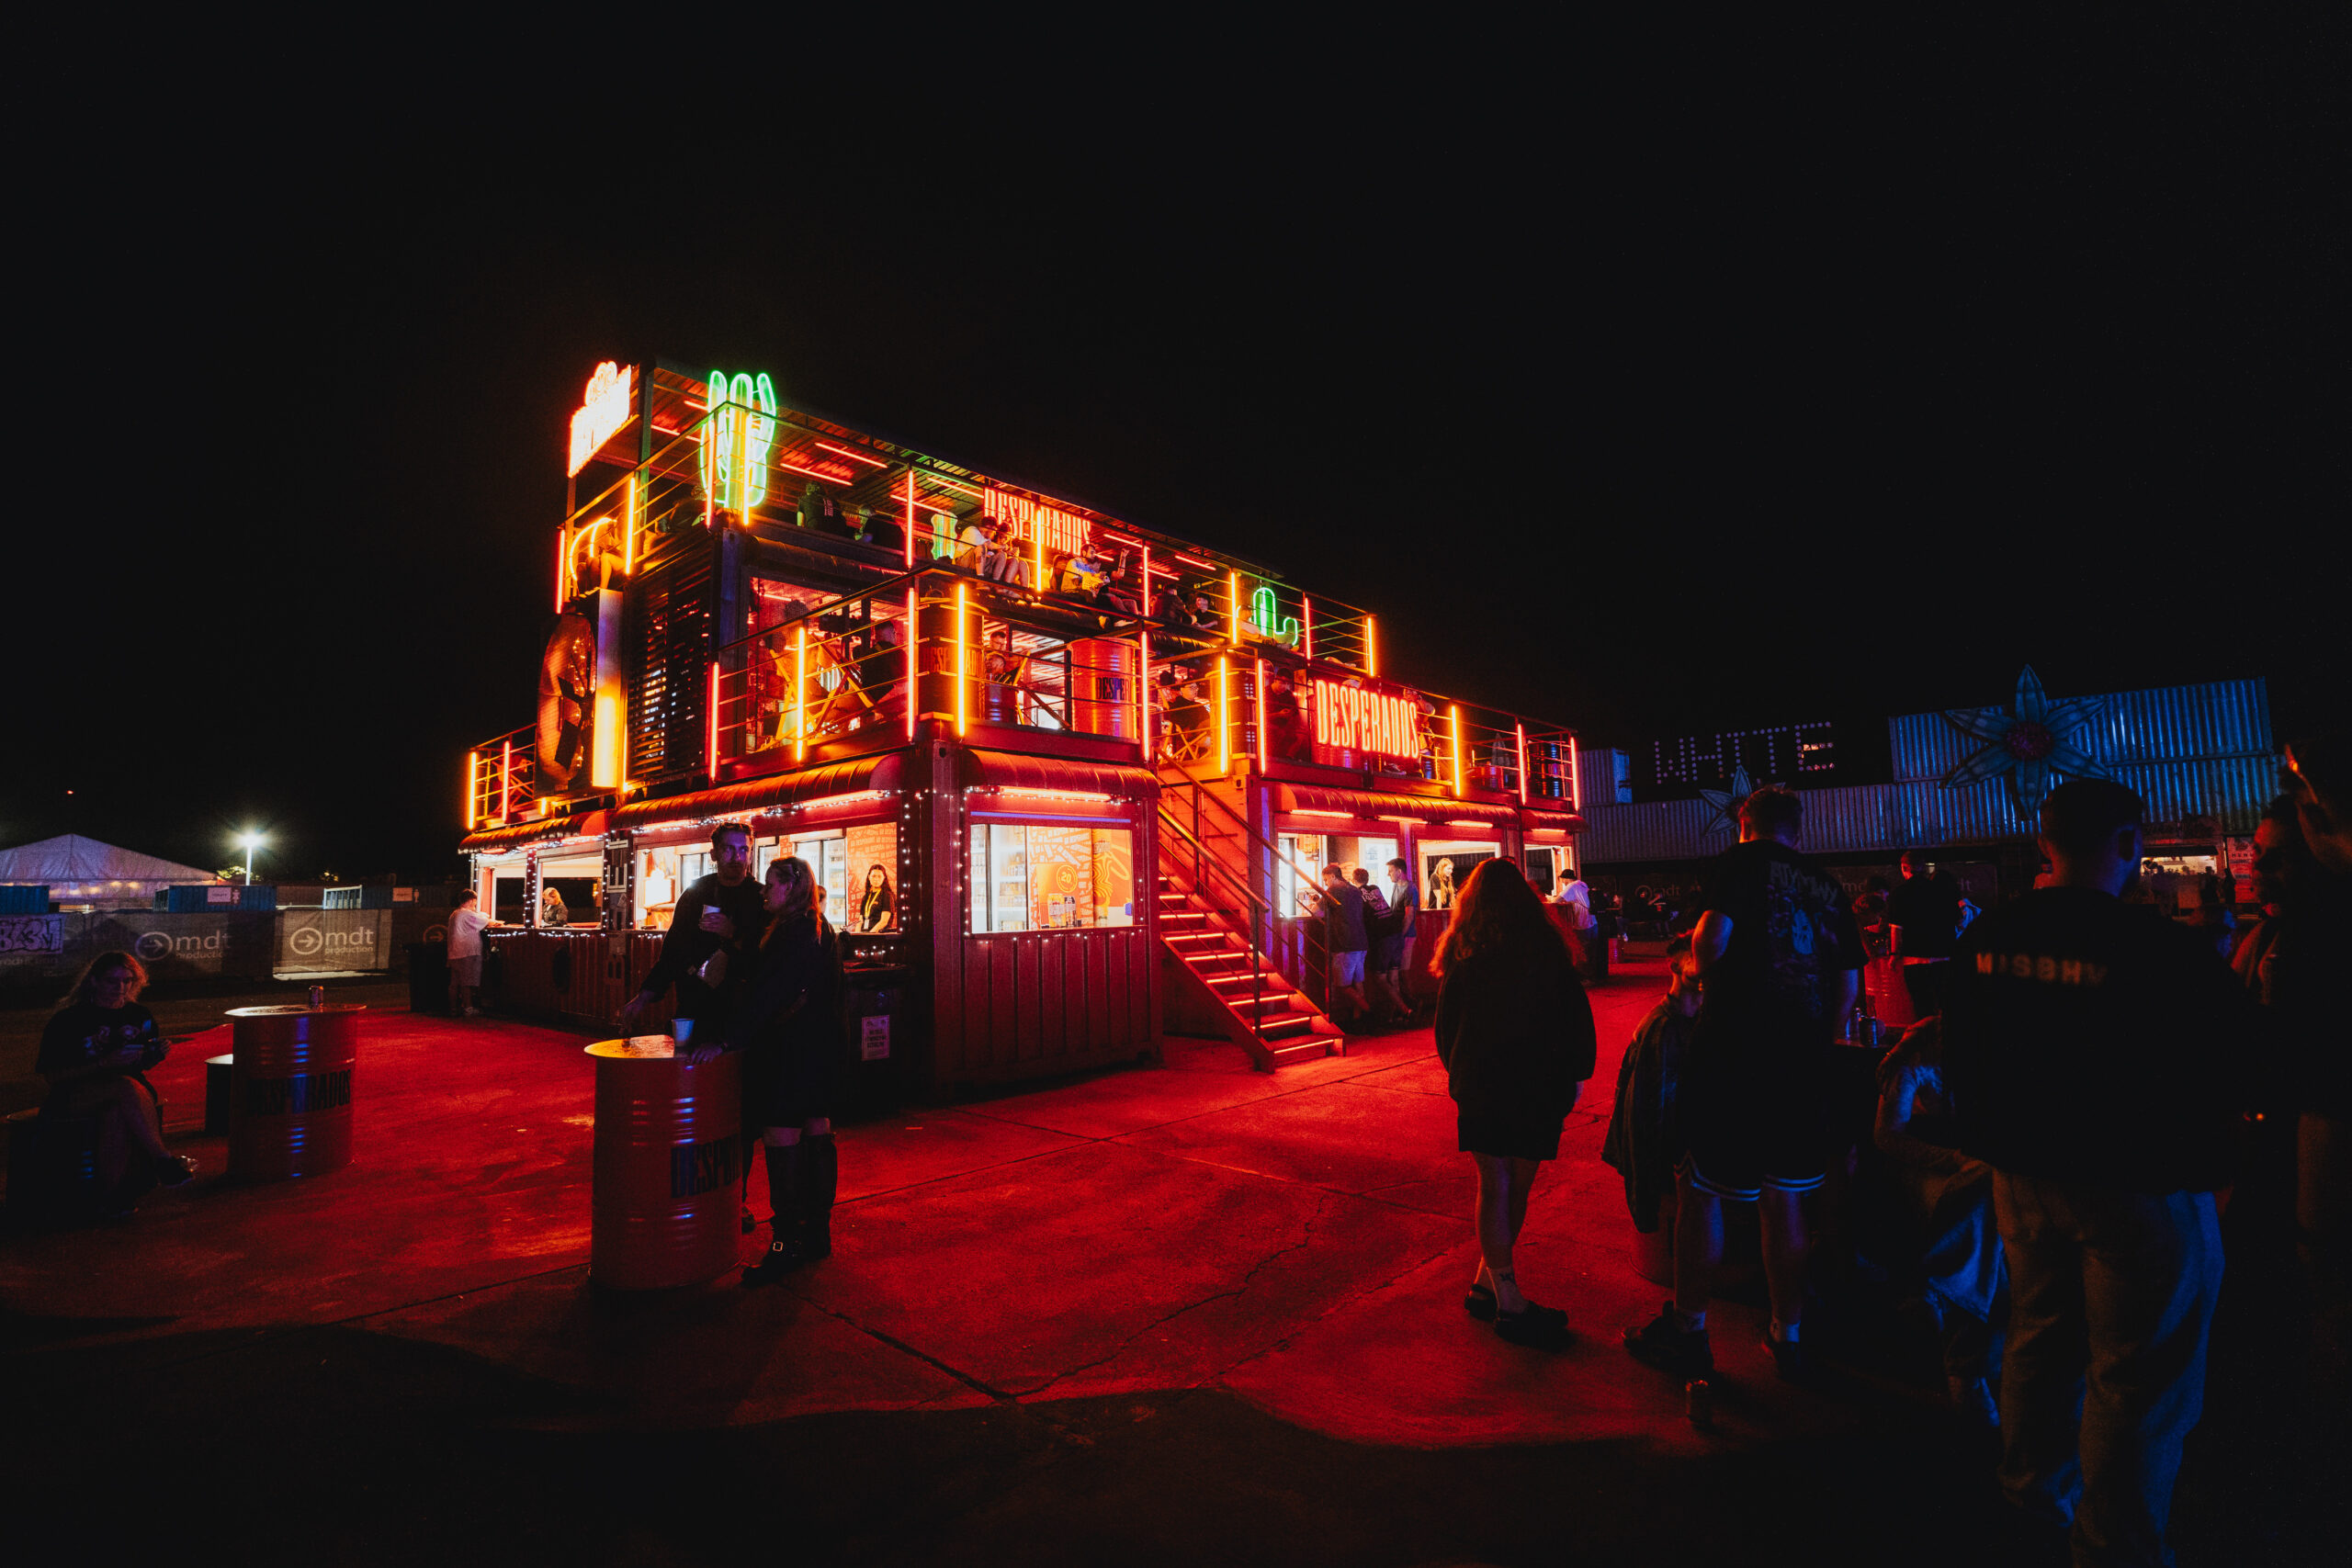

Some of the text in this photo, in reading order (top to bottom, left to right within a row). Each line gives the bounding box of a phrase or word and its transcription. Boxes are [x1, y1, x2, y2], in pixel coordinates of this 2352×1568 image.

[1316, 680, 1419, 759] DESPERADOS
[1654, 720, 1835, 784] WHITE
[176, 929, 232, 950] mdt
[324, 926, 374, 945] mdt
[324, 945, 374, 954] production
